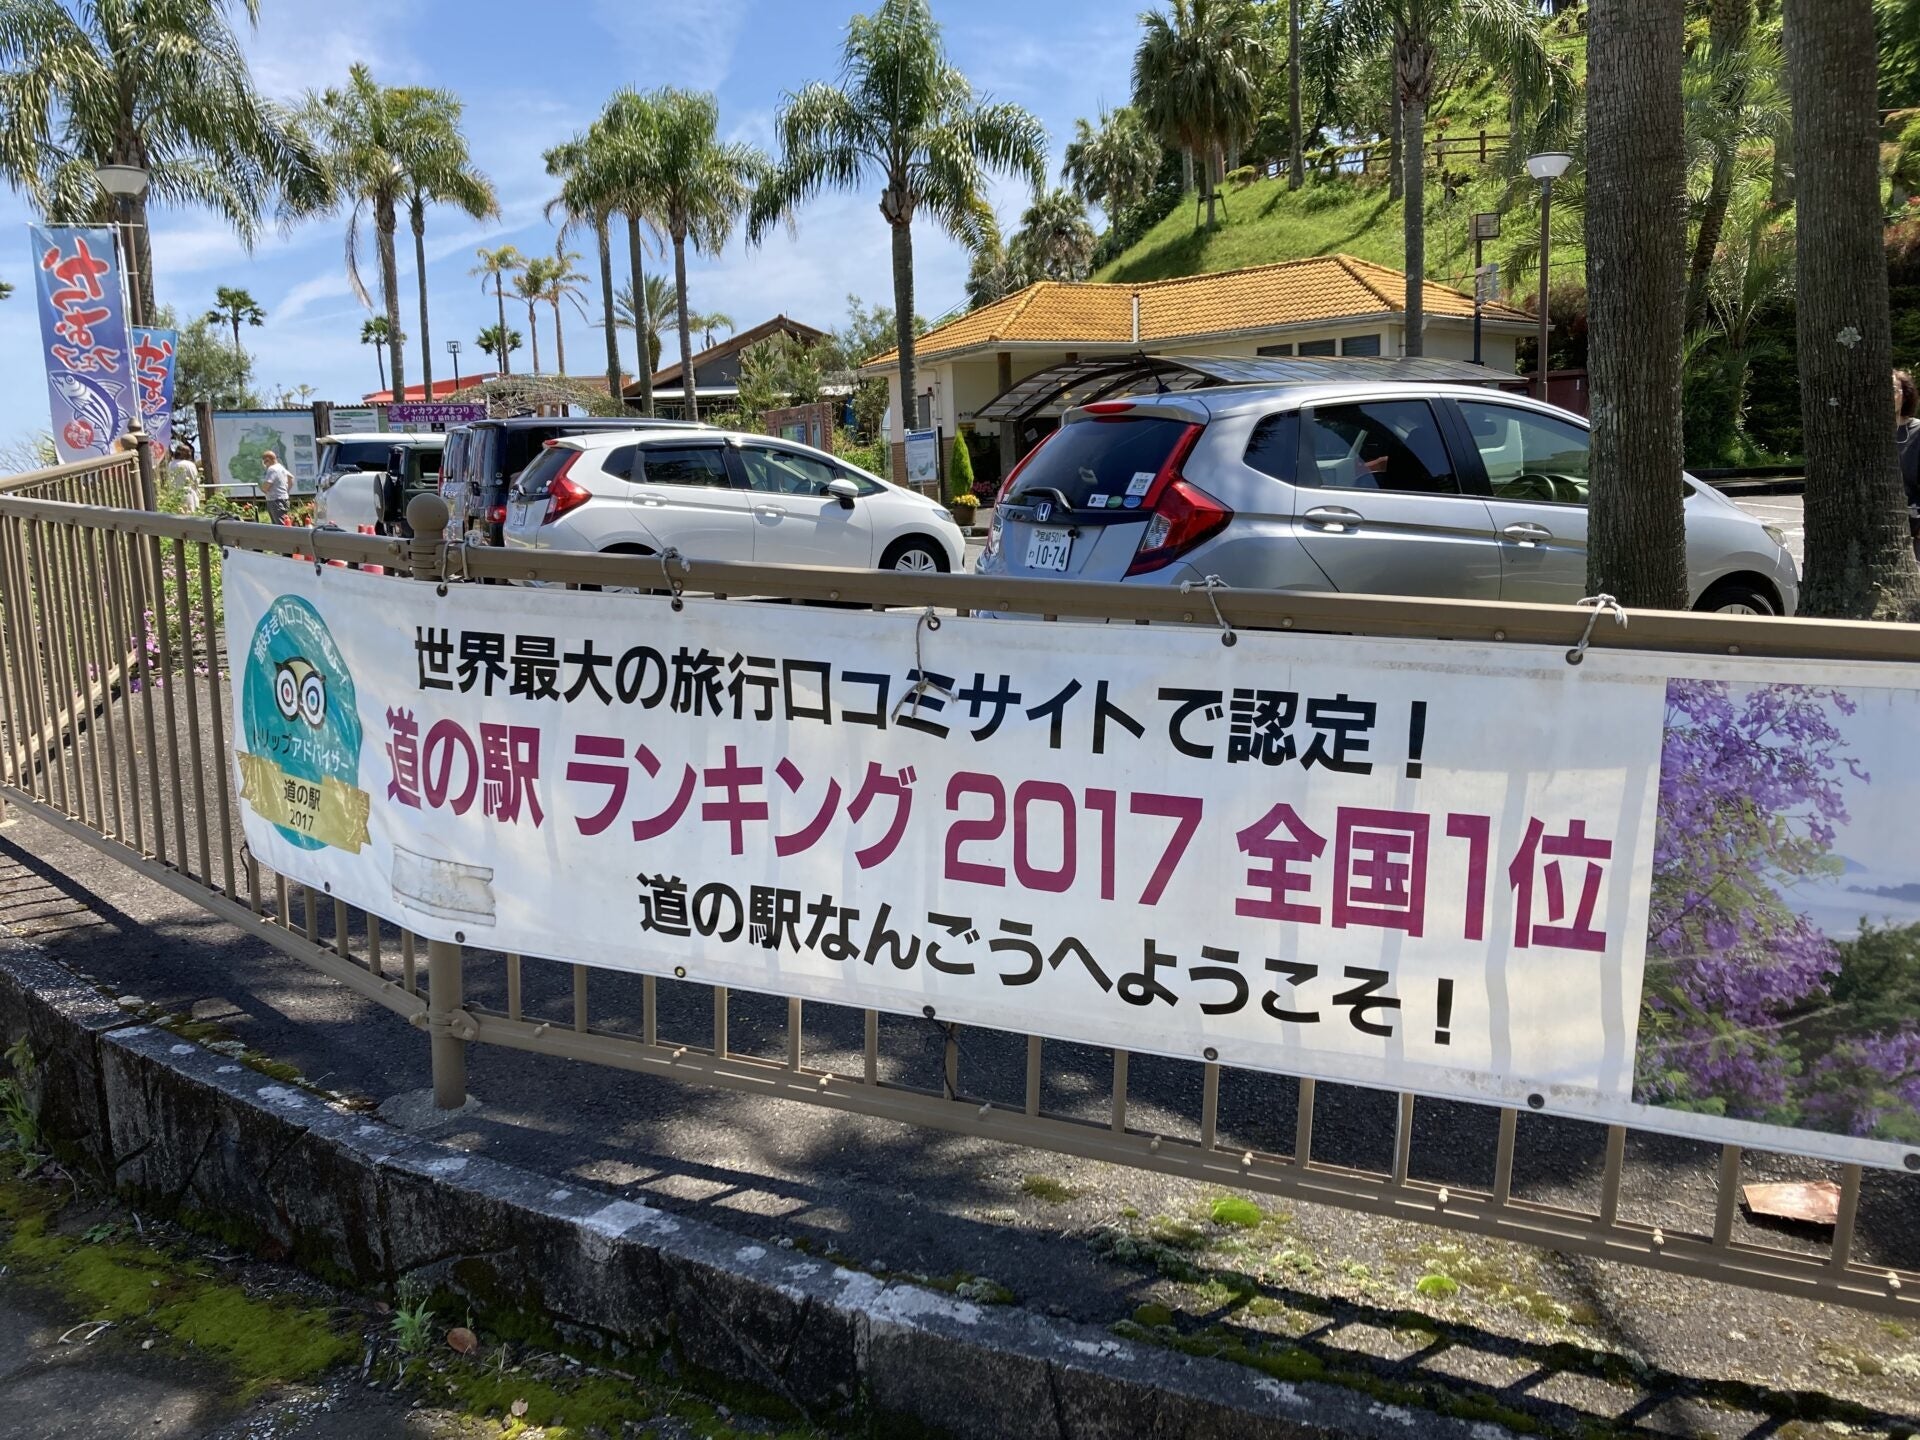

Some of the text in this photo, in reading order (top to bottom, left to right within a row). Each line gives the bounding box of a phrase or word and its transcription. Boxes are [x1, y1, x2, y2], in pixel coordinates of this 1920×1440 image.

[403, 406, 470, 415] ジャカランダまつり
[1036, 544, 1066, 567] 10-74
[284, 779, 320, 811] 道の駅
[290, 809, 314, 832] 2017
[385, 705, 1613, 953] 道の駅 ランキング 2017 全国1位
[635, 872, 1454, 1045] 道の駅なんごうへようこそ！
